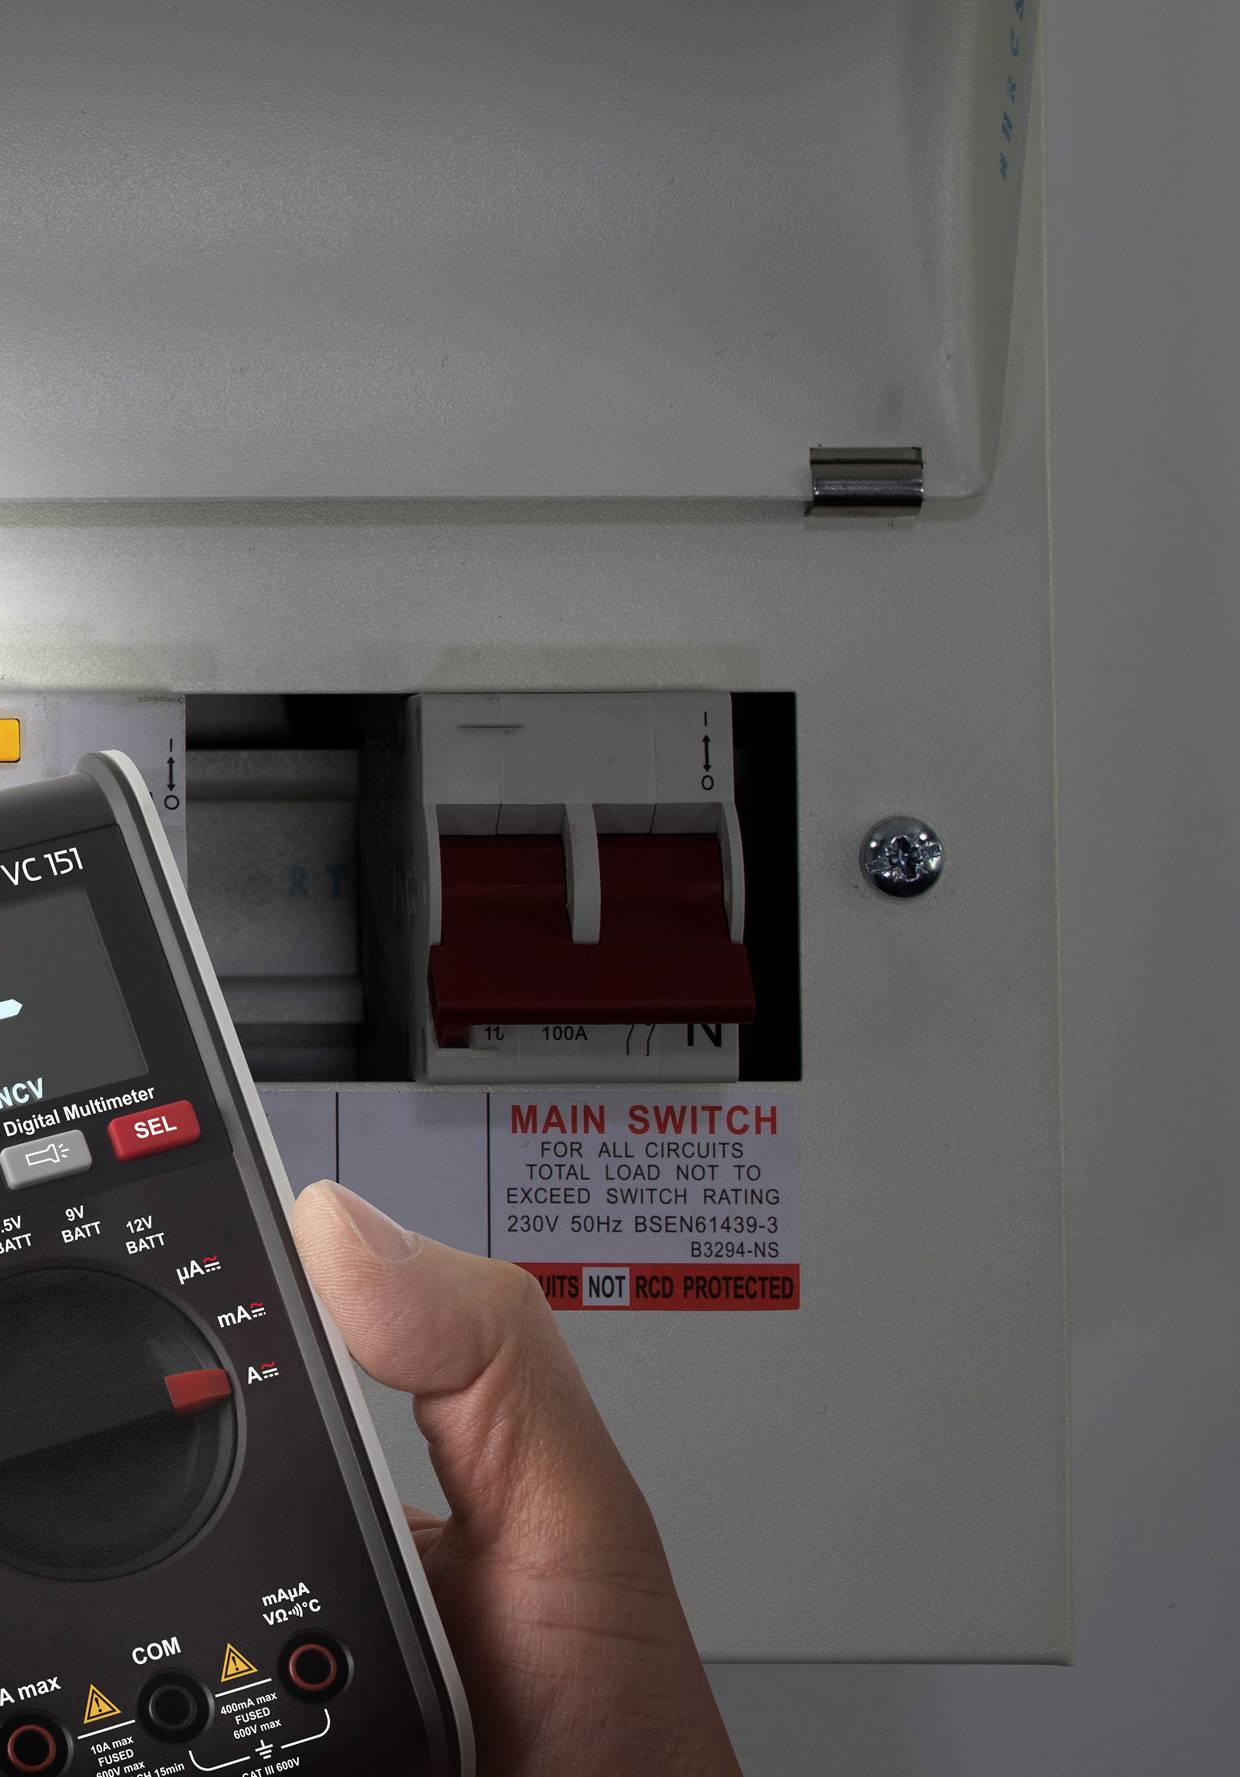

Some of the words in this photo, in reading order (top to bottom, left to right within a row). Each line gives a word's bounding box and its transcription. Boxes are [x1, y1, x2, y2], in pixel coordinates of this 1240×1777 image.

[0, 857, 42, 886] VC
[43, 847, 84, 876] 151
[542, 1025, 588, 1041] 100A
[2, 1108, 61, 1137] Digital
[62, 1087, 155, 1121] Multimeter
[511, 1104, 605, 1135] MAIN
[627, 1104, 778, 1135] SWITCH
[134, 1115, 178, 1139] SEL
[541, 1141, 583, 1158] FOR
[598, 1141, 635, 1159] ALL
[645, 1141, 744, 1159] CIRCUITS
[525, 1163, 591, 1181] TOTAL
[605, 1163, 661, 1181] LOAD
[676, 1164, 719, 1182] NOT
[733, 1164, 761, 1182] TO
[506, 1187, 591, 1205] EXCEED
[606, 1187, 687, 1205] SWITCH
[703, 1188, 780, 1206] RATING
[65, 1205, 84, 1222] 9V
[61, 1220, 101, 1244] BATT
[126, 1215, 152, 1234] 12V
[507, 1214, 559, 1233] 230V
[570, 1215, 623, 1233] 50Hz
[634, 1215, 778, 1234] BSEN61439-3
[125, 1232, 165, 1255] BATT
[690, 1241, 779, 1259] B3294-NS
[588, 1275, 626, 1299] NOT
[636, 1275, 674, 1299] RCD
[683, 1275, 795, 1300] PROTECTED
[131, 1636, 182, 1665] COM
[17, 1676, 62, 1701] max
[220, 1697, 256, 1715] 400mA
[255, 1692, 278, 1705] max
[234, 1706, 271, 1725] FUSED
[233, 1723, 257, 1740] 600V
[260, 1719, 282, 1732] max
[90, 1742, 111, 1755] 10A
[111, 1736, 134, 1749] max
[97, 1748, 134, 1767] FUSED
[275, 1756, 300, 1772] 600V
[123, 1761, 146, 1774] max
[154, 1762, 185, 1777] 15min
